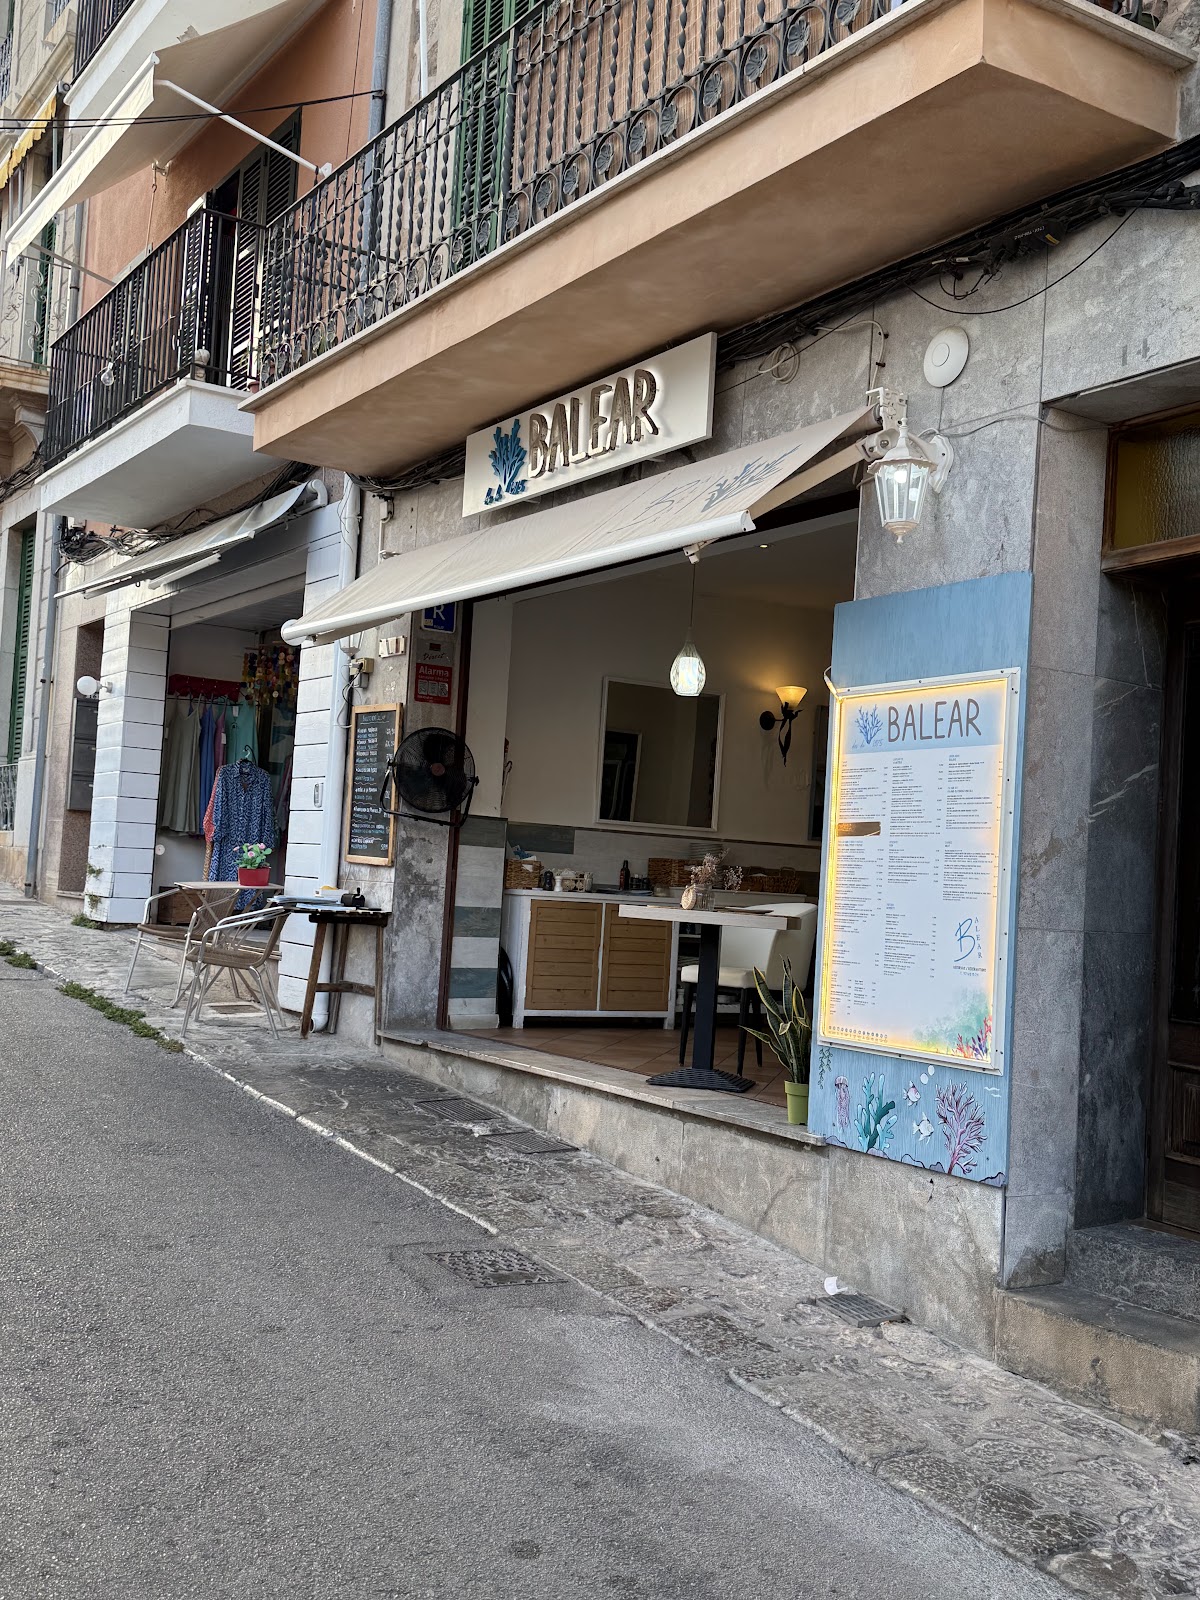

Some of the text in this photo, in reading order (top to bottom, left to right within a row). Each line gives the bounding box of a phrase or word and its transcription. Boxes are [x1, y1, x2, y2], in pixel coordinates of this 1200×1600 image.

[528, 368, 659, 479] BALEAR
[433, 604, 446, 621] R
[418, 665, 449, 678] Alarma
[887, 698, 982, 743] BALEAR
